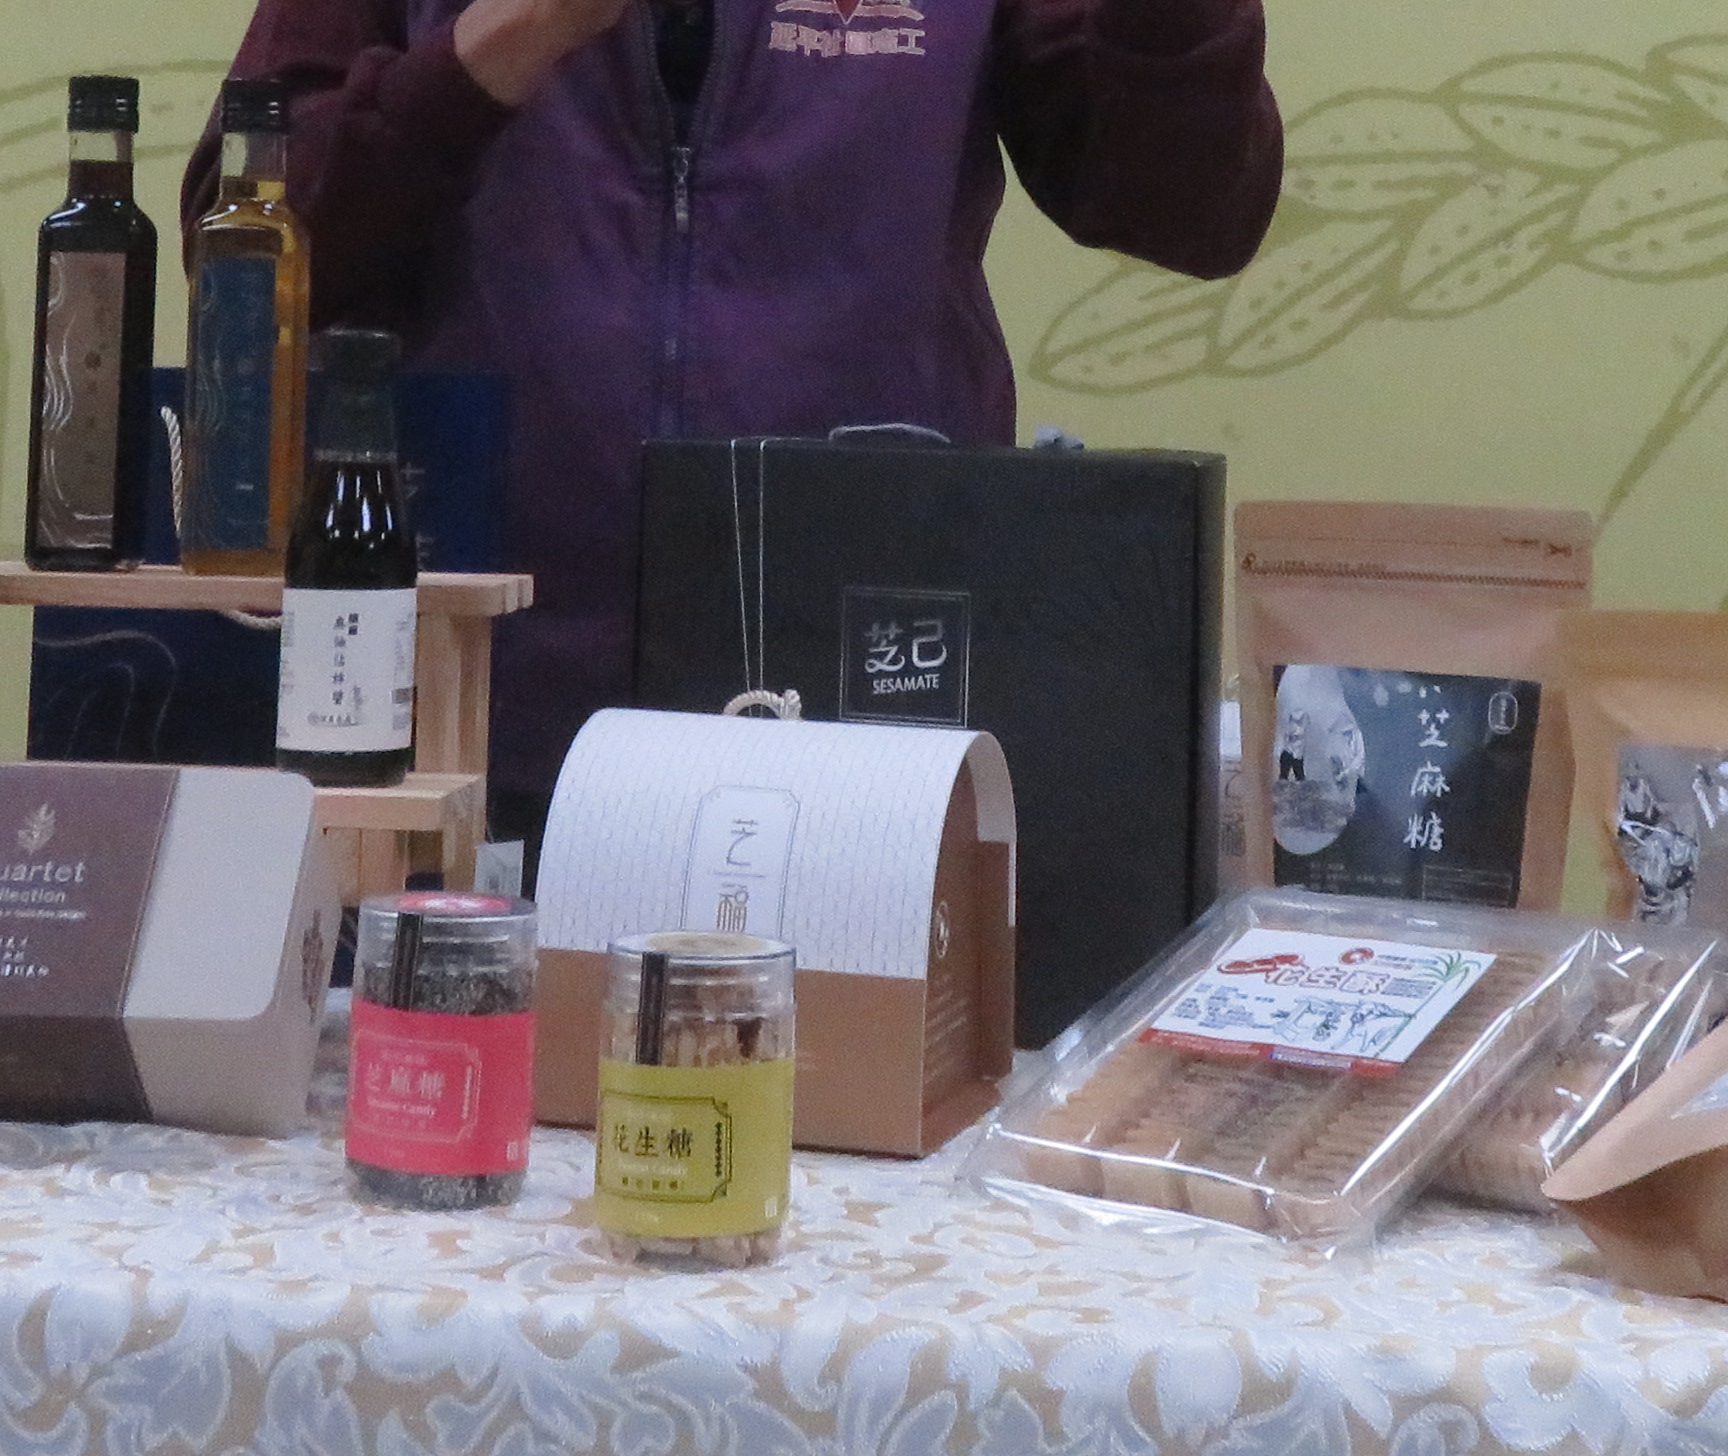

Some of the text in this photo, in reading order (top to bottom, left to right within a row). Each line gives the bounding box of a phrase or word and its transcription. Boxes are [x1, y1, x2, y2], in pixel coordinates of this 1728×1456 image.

[872, 673, 941, 696] SESAMATE
[1402, 707, 1451, 853] 芝麻糖
[612, 1123, 694, 1160] 花生糖
